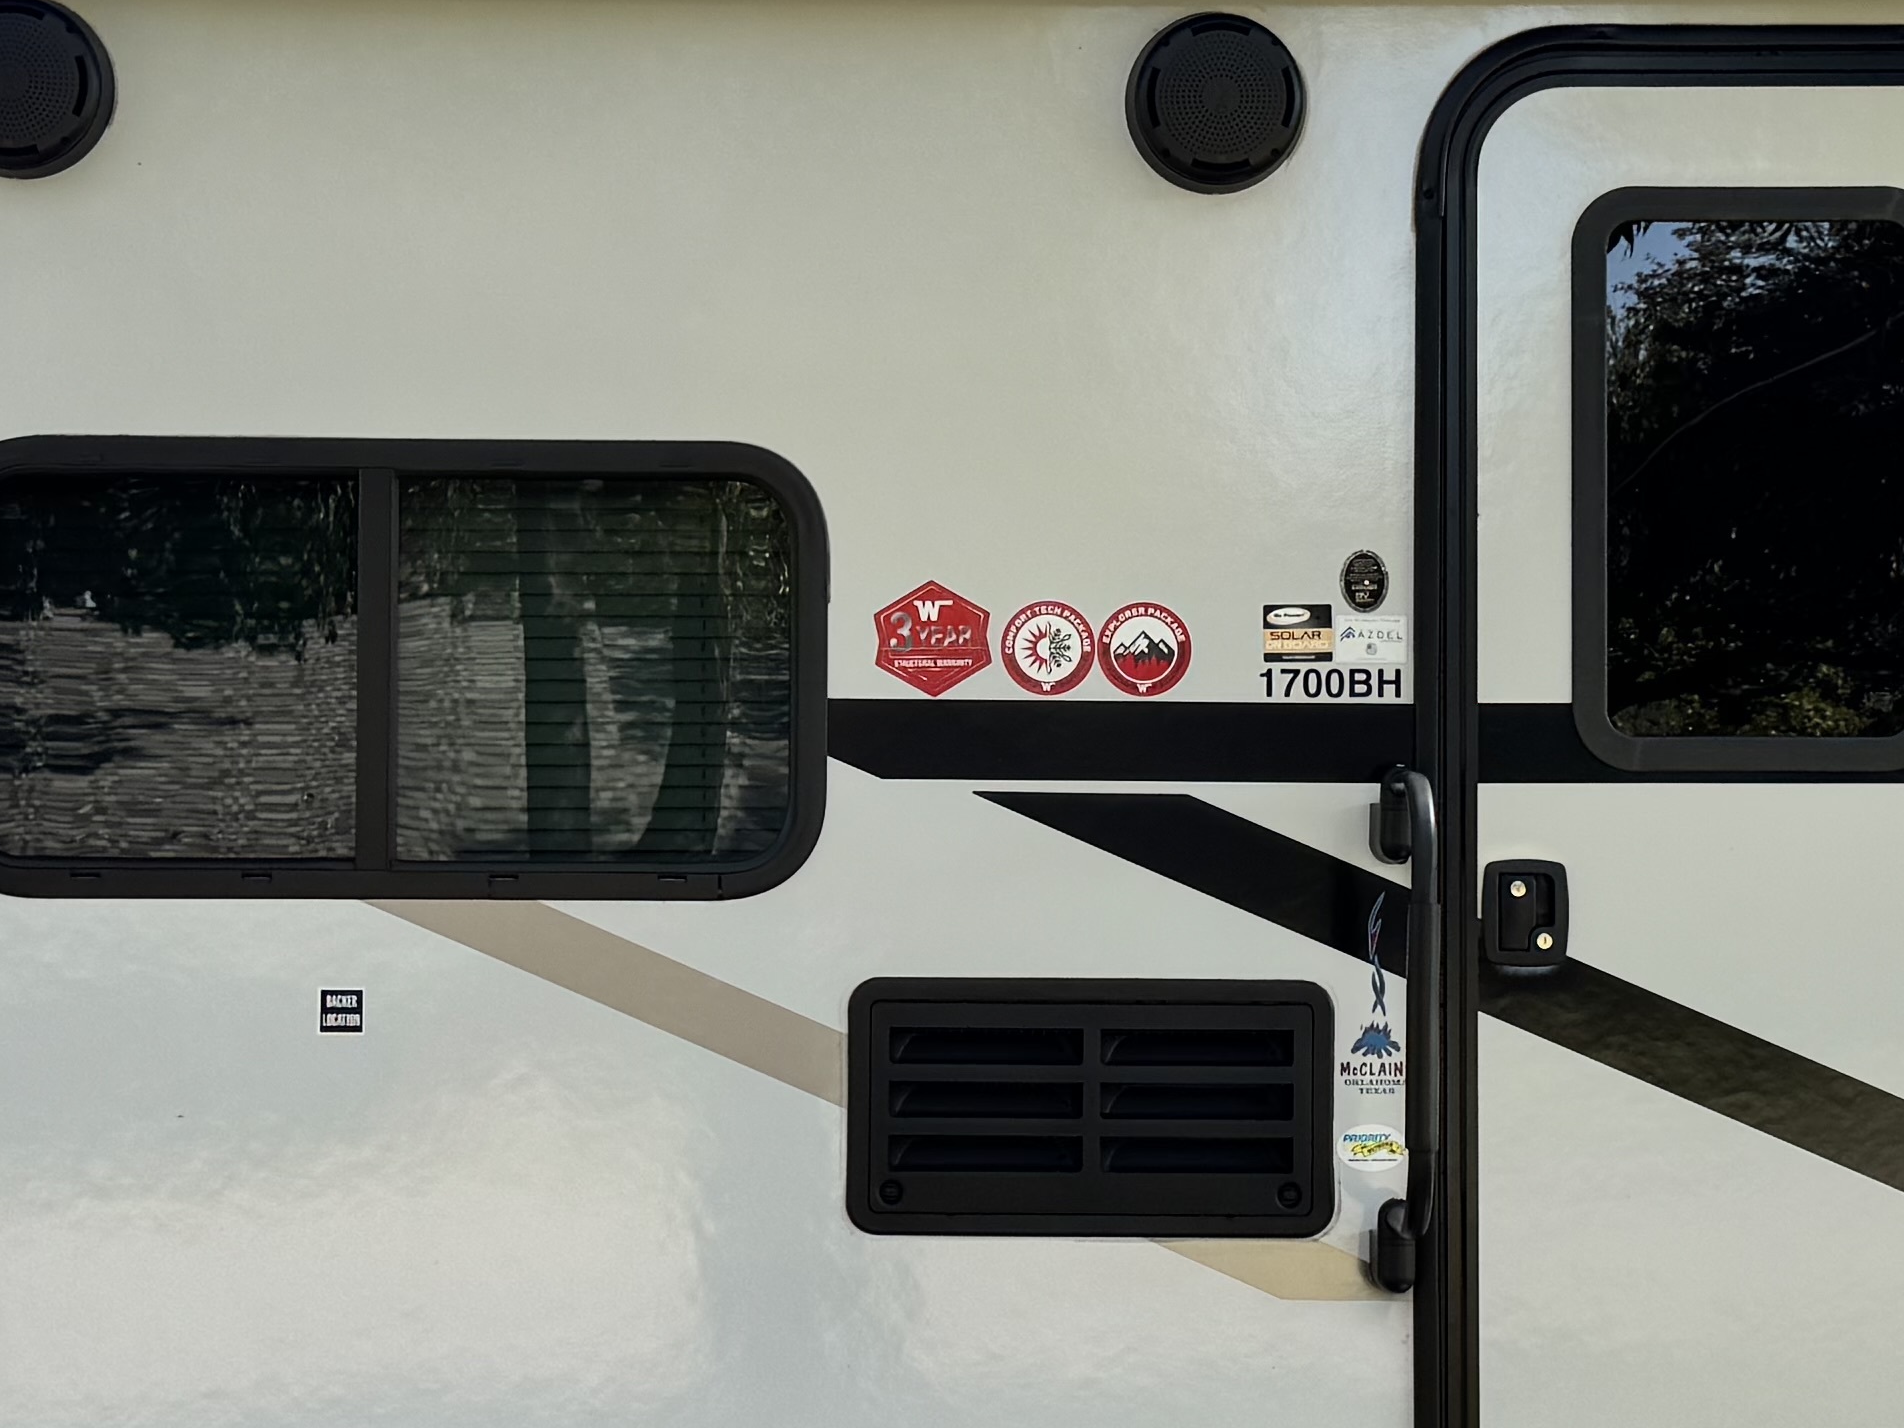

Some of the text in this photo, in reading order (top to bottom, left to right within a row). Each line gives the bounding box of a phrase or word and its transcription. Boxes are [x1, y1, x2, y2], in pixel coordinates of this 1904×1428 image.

[890, 611, 972, 653] 3 YEAR
[1034, 605, 1061, 616] TECH
[1062, 608, 1092, 653] PACKAGE
[1102, 607, 1186, 644] EXPLORER PACKAGE
[1270, 630, 1322, 641] SOLAR
[1358, 630, 1403, 640] AZDEL
[1259, 668, 1401, 699] 1700BH
[326, 994, 357, 1008] BACKER
[322, 1013, 361, 1026] LOCATION
[1344, 1078, 1405, 1086] OKLAHOM
